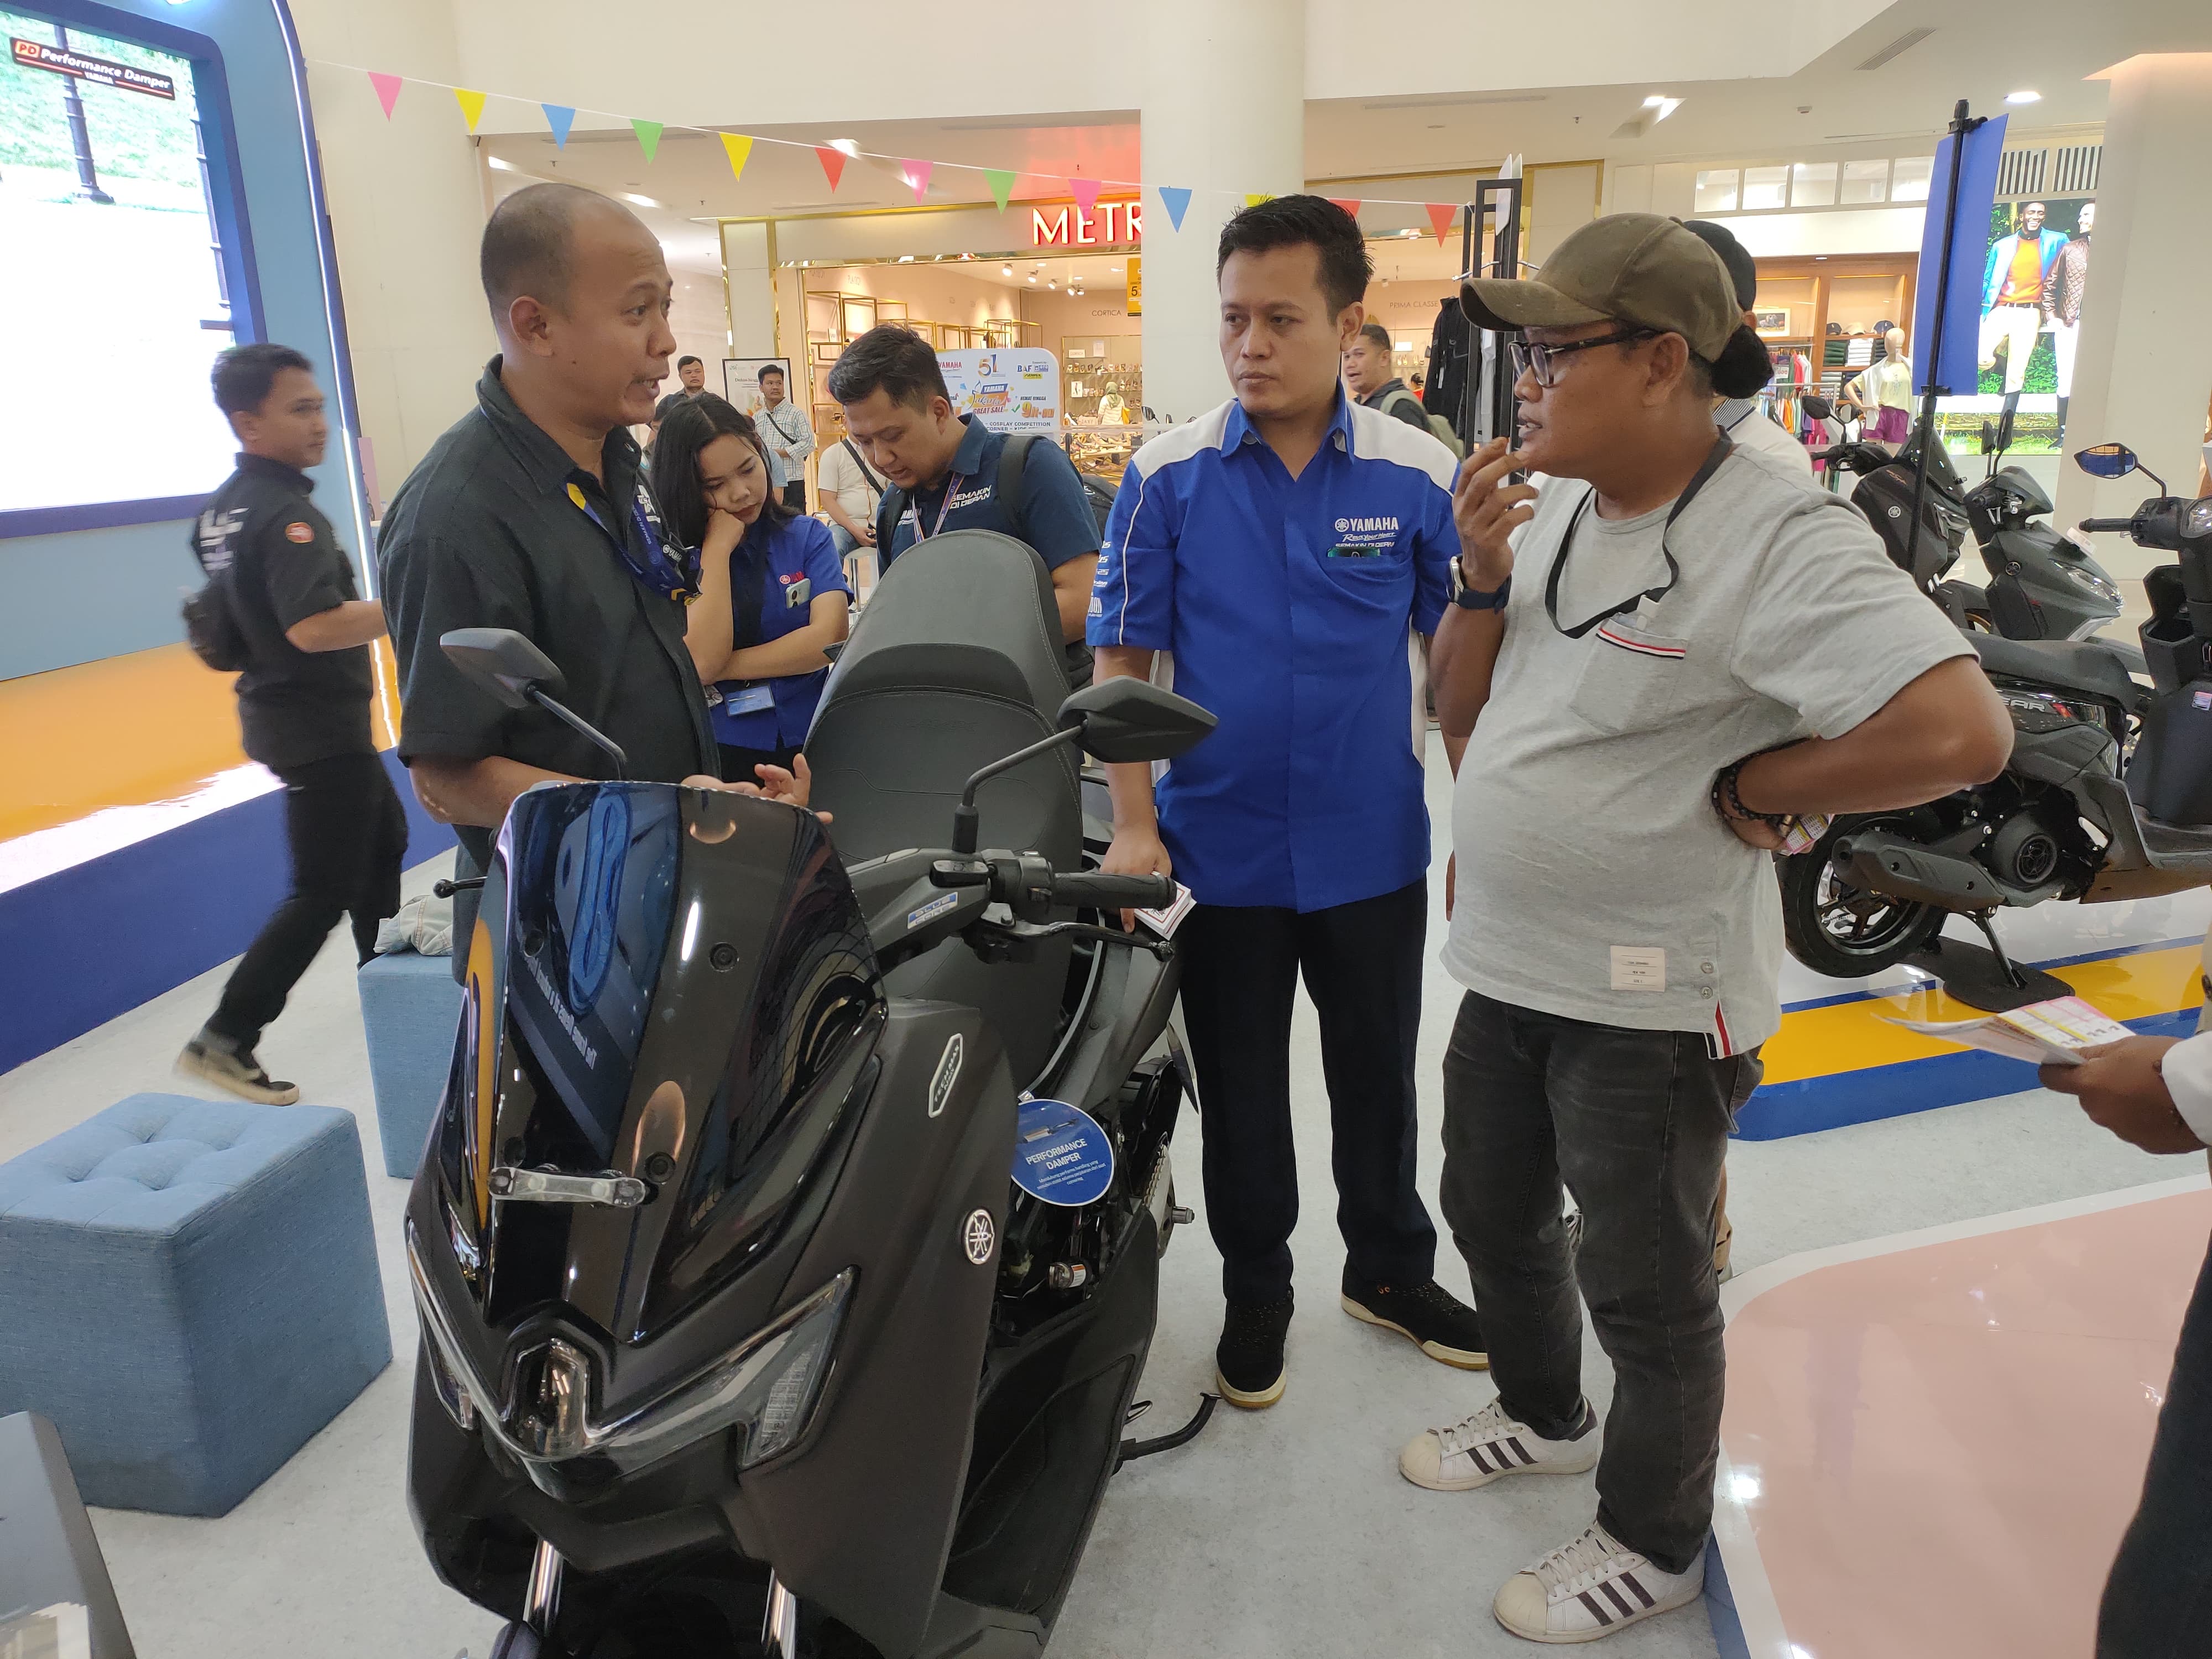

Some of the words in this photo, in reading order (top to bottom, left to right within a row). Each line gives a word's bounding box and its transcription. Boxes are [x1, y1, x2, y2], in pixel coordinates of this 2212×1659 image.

[41, 48, 123, 77] Performance
[124, 69, 171, 88] Damper
[949, 500, 960, 510] DI
[960, 491, 991, 507] DEPAN
[951, 484, 992, 503] SEMAKIN
[1349, 517, 1399, 532] YAMAHA
[1025, 1138, 1088, 1165] PERFORMANCE
[1046, 1152, 1082, 1170] DAMPER
